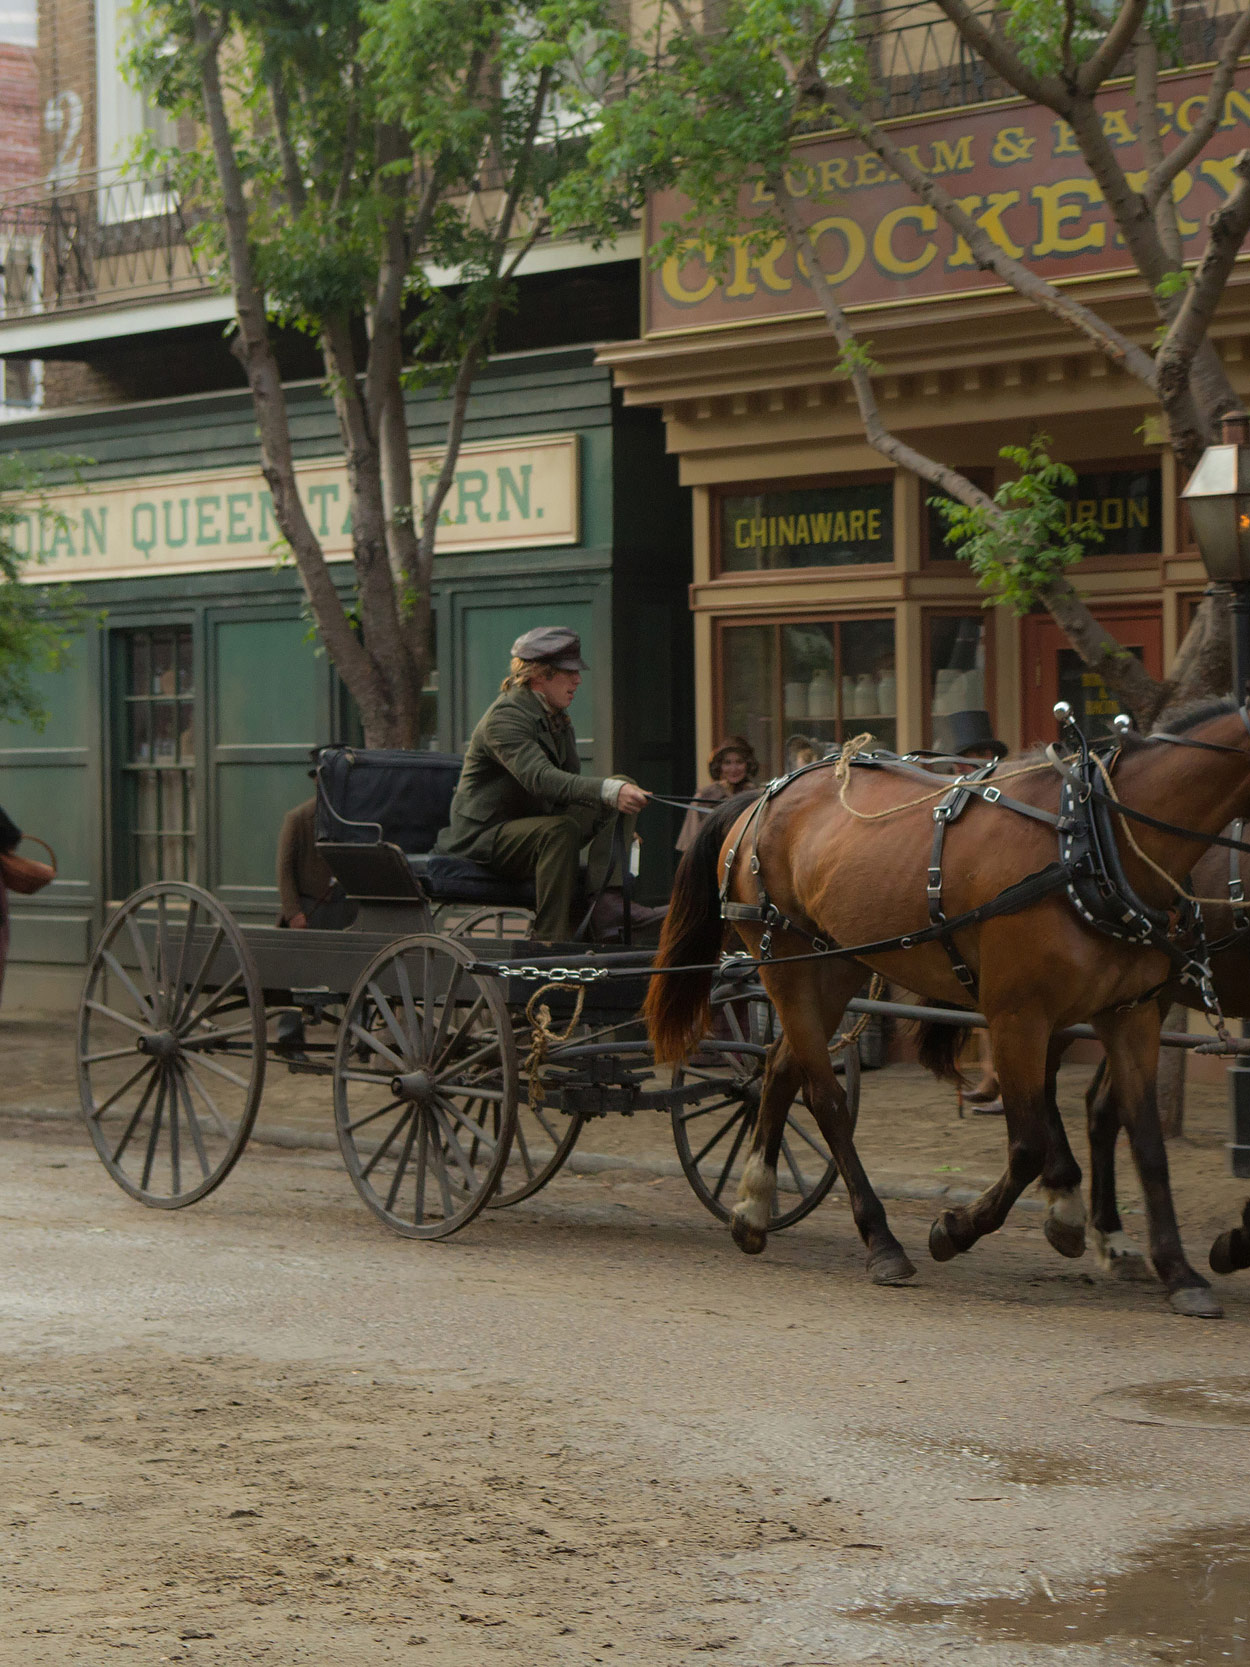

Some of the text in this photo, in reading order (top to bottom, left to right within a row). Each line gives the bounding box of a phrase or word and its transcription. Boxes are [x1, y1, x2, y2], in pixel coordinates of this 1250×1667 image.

[44, 88, 84, 191] 2
[993, 126, 1036, 163] &
[735, 509, 882, 549] CHINAWARE
